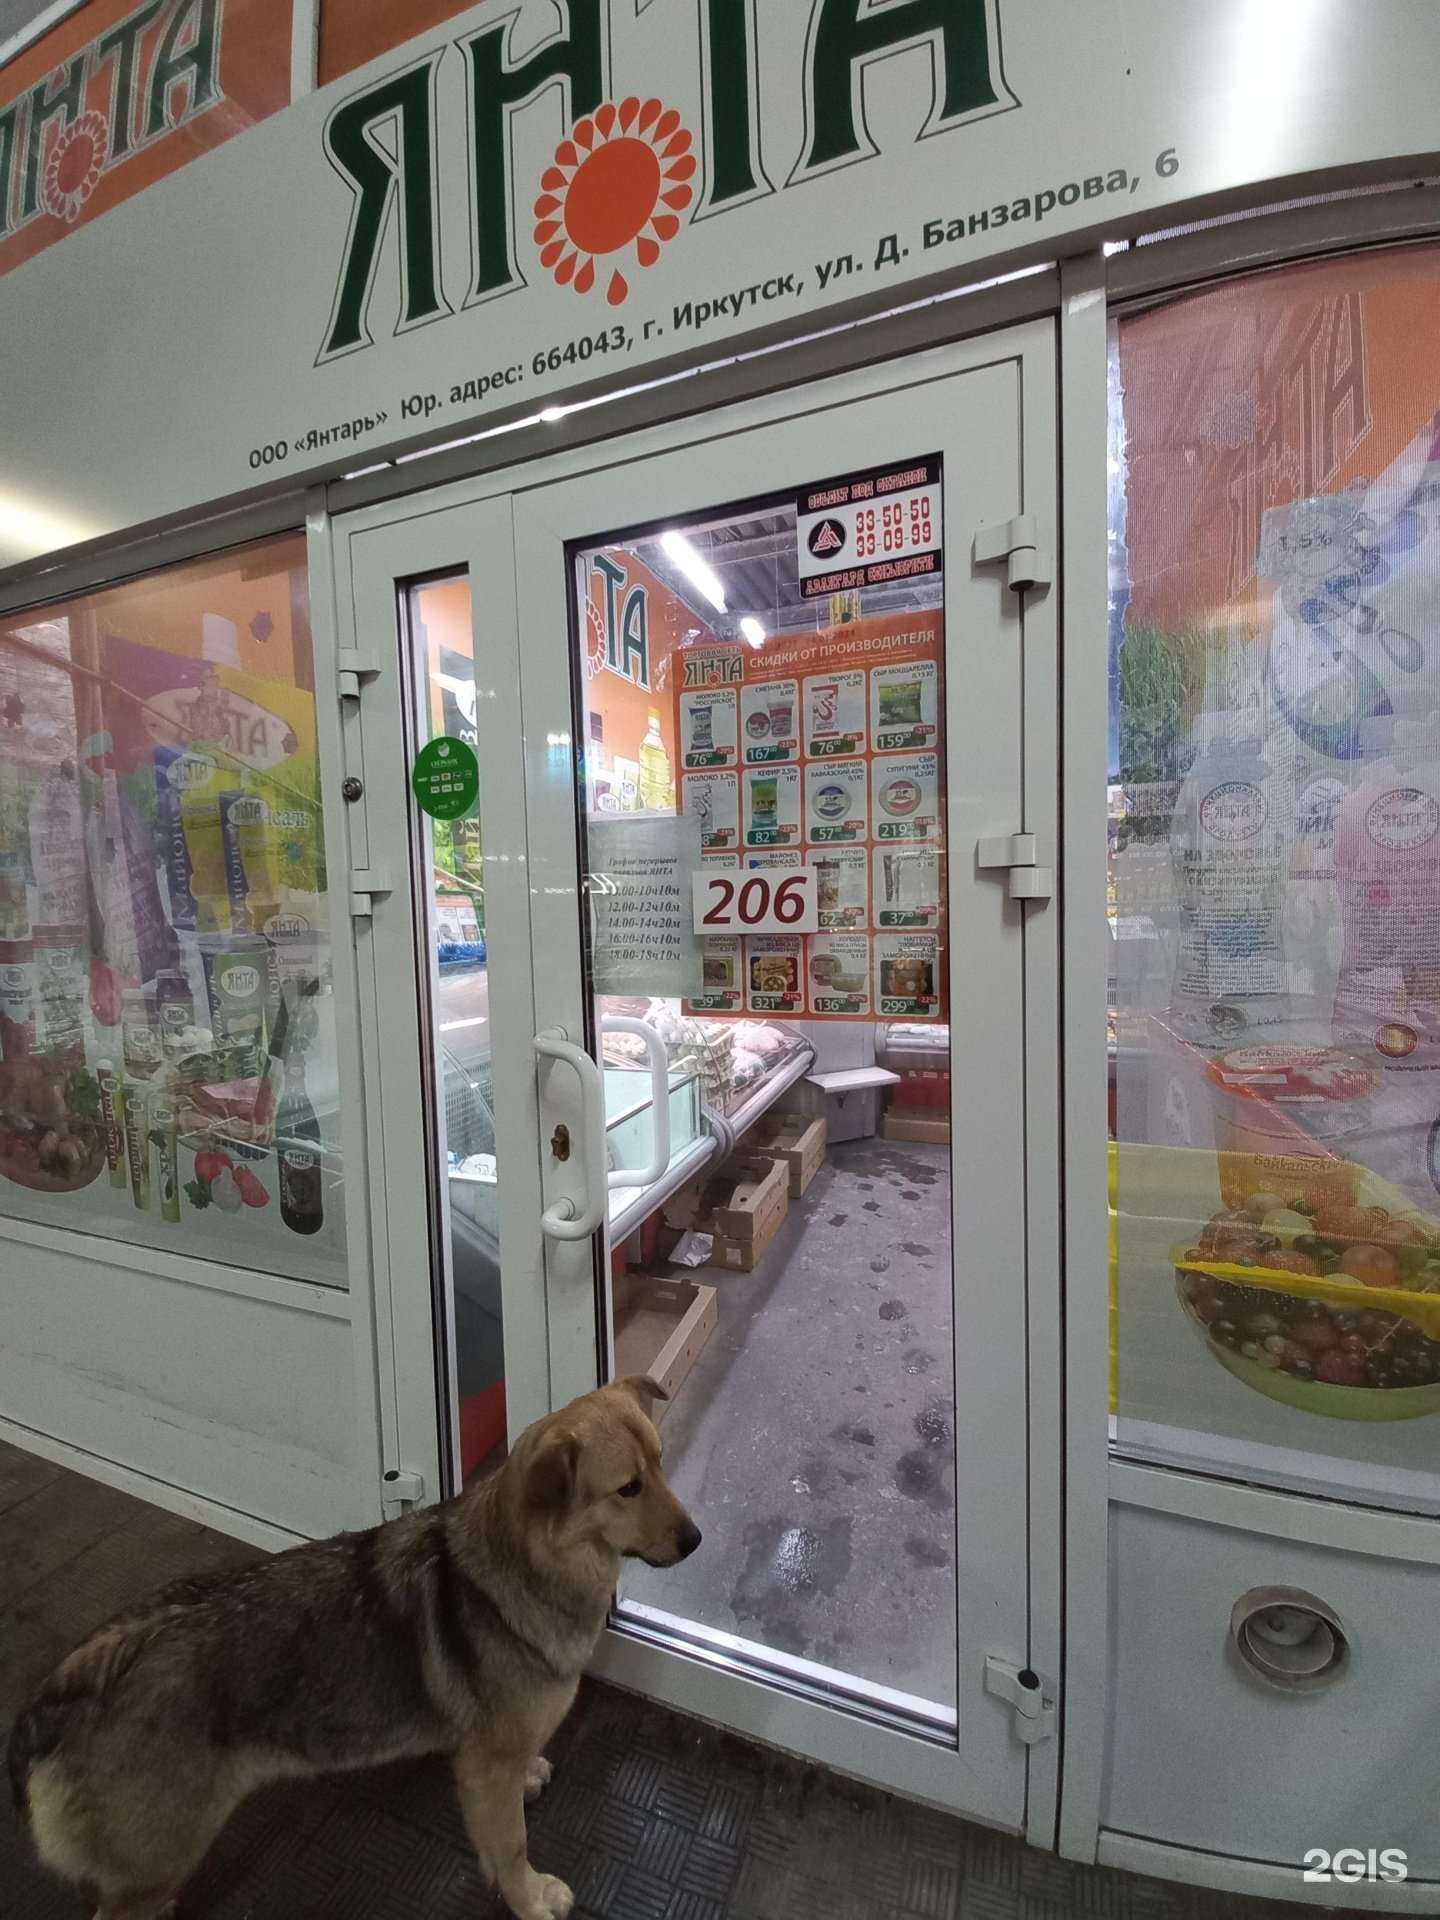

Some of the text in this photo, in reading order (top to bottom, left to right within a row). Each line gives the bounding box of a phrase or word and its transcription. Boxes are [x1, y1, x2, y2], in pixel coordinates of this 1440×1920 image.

[249, 147, 1180, 468] ООО «Янтарь» Юр. адрес: 664043, г. Иркутск, ул. Д. Банзарова, 6
[856, 496, 930, 533] 33-50-50
[856, 521, 932, 557] 33-09-99
[592, 553, 652, 694] ТА
[749, 651, 798, 669] СКИДКИ
[800, 647, 817, 660] ОТ
[819, 630, 935, 657] ПРОИЗВОДИТЕЛЯ
[683, 655, 743, 687] ЯНТА
[608, 884, 680, 897] .00-10ч10м
[702, 875, 808, 925] 206
